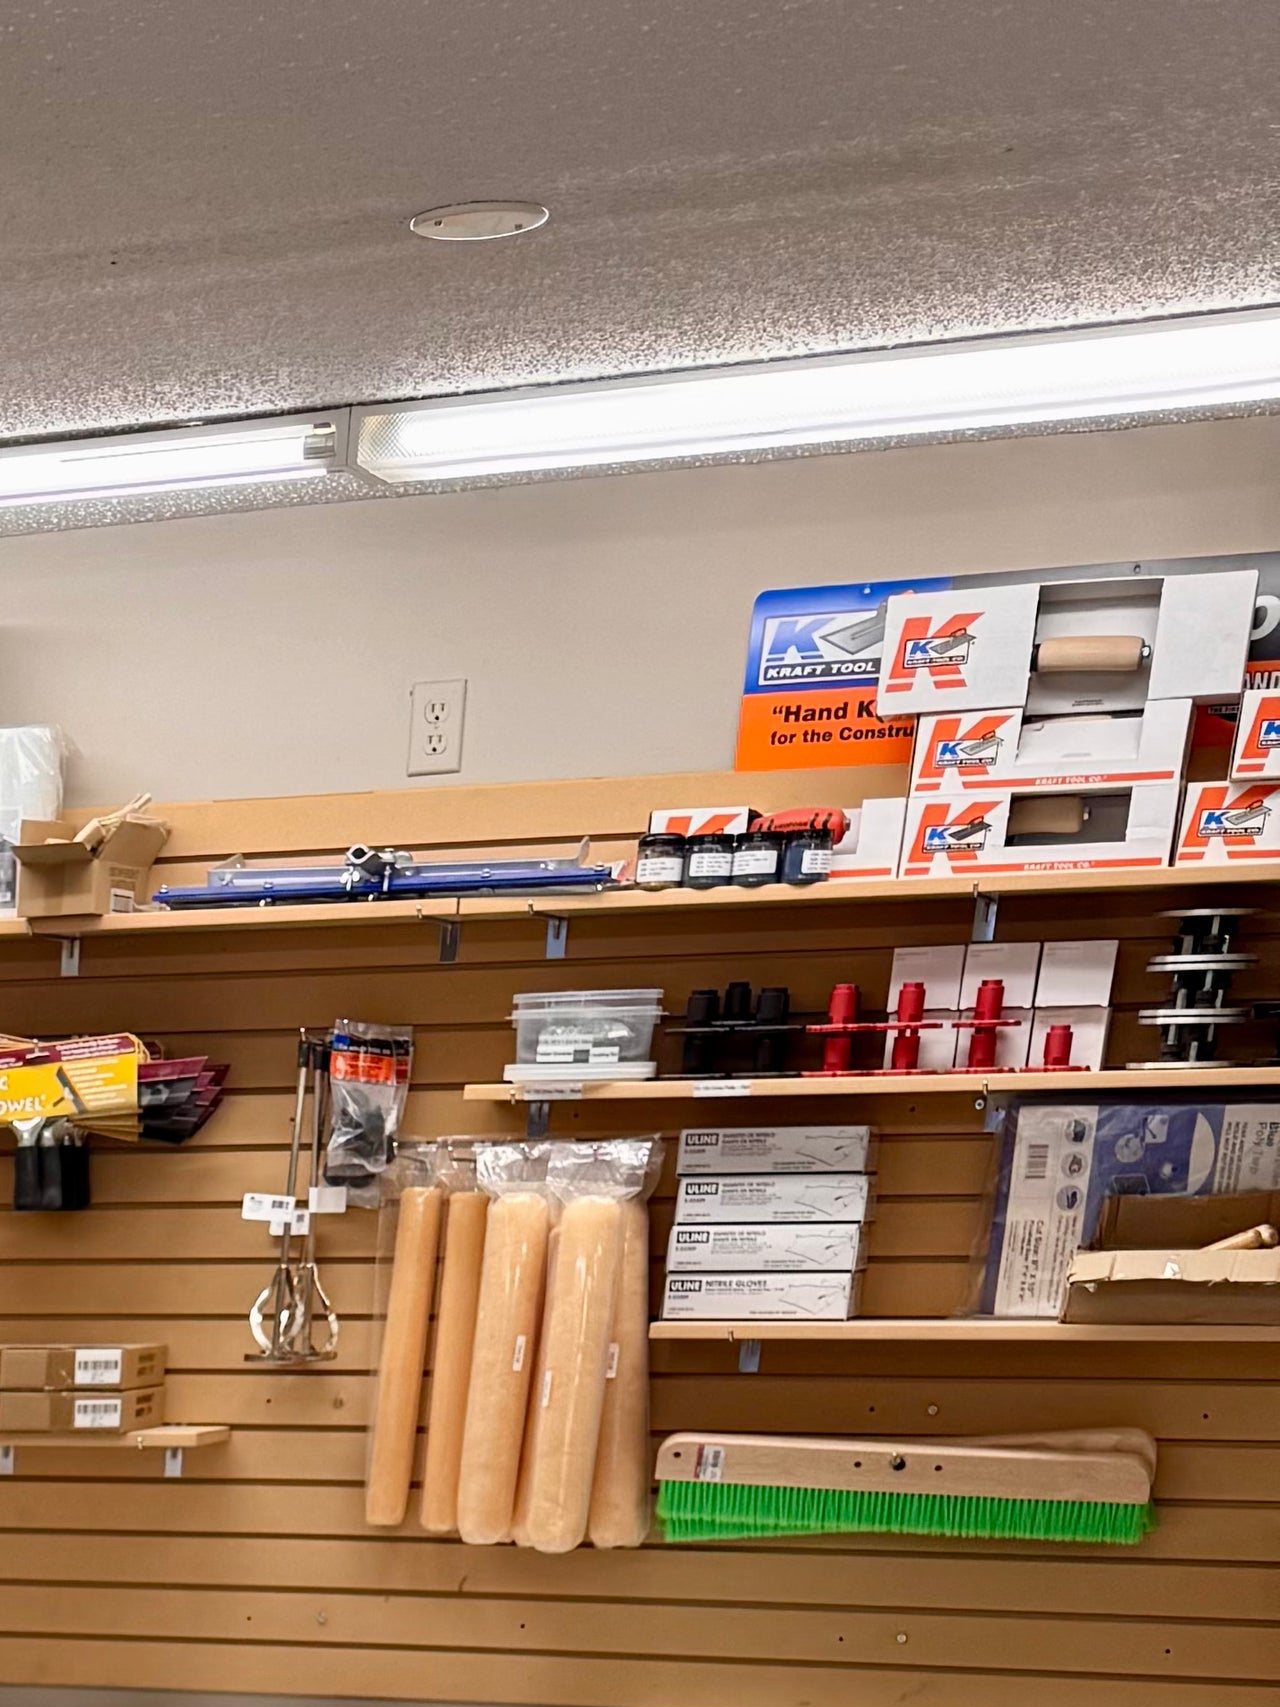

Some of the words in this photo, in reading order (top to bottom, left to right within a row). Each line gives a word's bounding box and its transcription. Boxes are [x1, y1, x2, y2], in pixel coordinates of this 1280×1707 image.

[766, 663, 826, 680] KRAFT
[831, 659, 876, 674] TOOL
[771, 731, 796, 746] for
[803, 729, 834, 742] the
[686, 1134, 718, 1146] ULINE
[686, 1183, 718, 1194] ULINE
[678, 1232, 709, 1243] ULINE
[670, 1281, 701, 1291] ULINE
